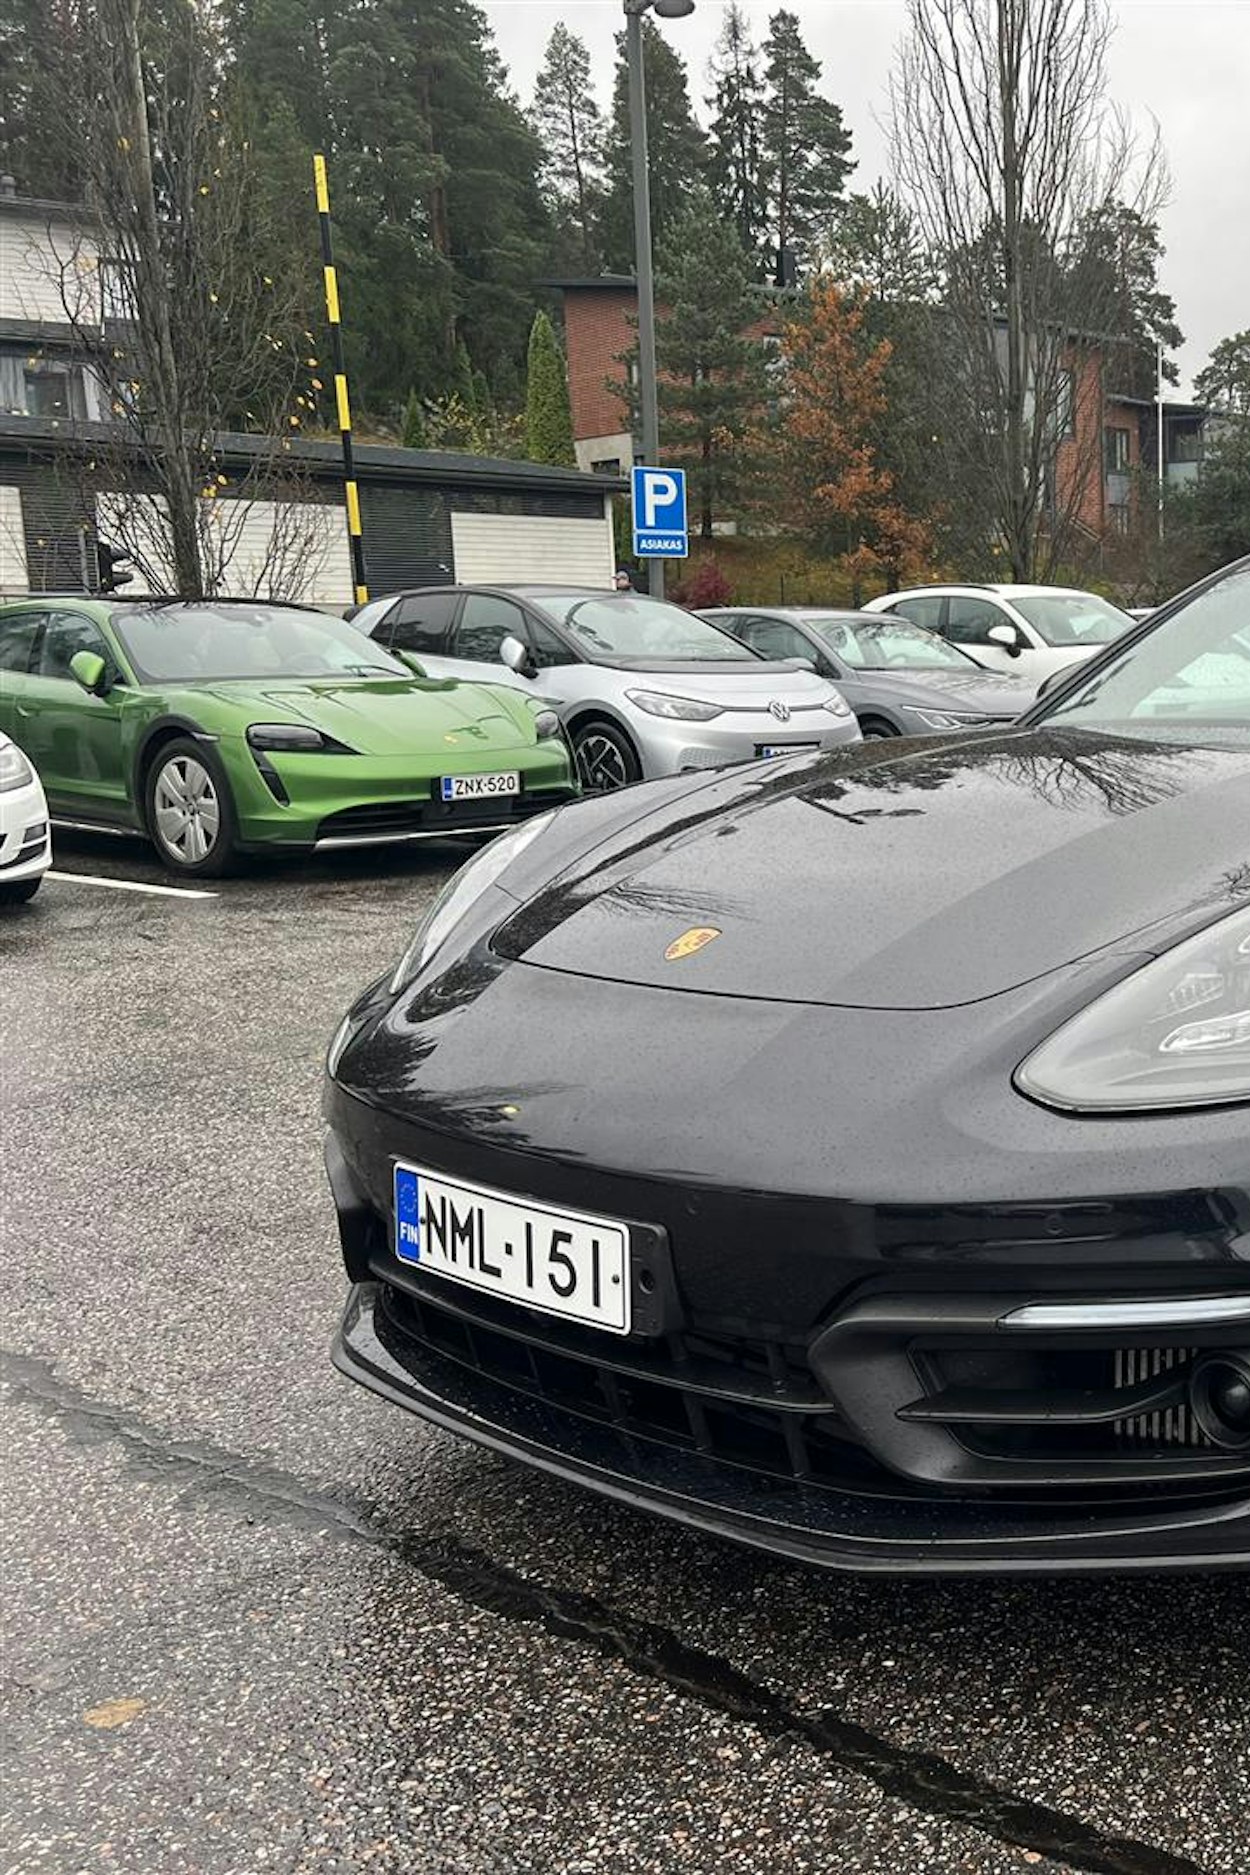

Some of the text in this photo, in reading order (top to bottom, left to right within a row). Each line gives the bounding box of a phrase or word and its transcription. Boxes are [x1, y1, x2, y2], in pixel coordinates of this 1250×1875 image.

[643, 472, 678, 528] P
[639, 538, 683, 552] ASIAKAS
[455, 776, 515, 796] ZNX-520
[400, 1221, 418, 1245] FIN
[425, 1190, 600, 1308] NML-151
